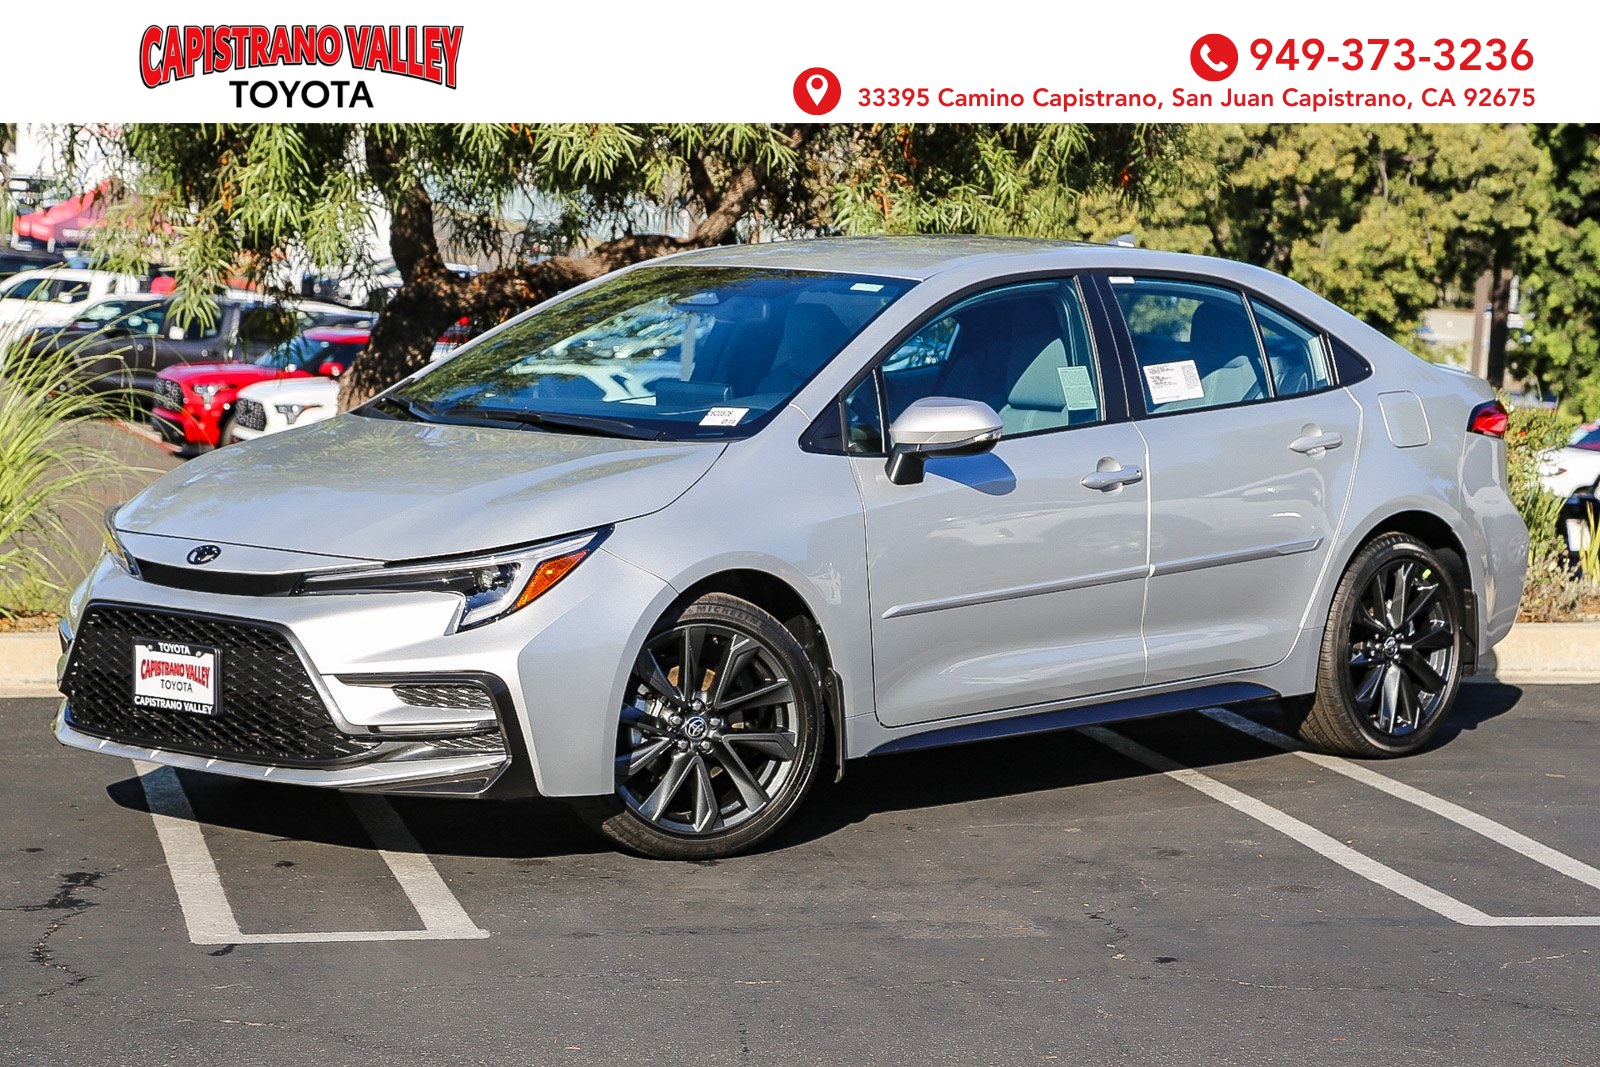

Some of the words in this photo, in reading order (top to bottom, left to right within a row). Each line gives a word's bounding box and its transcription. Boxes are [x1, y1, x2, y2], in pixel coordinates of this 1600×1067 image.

[696, 605, 764, 629] MICHELIN
[157, 642, 191, 655] TOYOTA
[140, 659, 185, 680] CAPISTRANO
[185, 663, 211, 689] VALLEY
[160, 679, 193, 693] TOYOTA
[134, 696, 183, 711] CAPISTRANO
[183, 702, 213, 715] VALLEY
